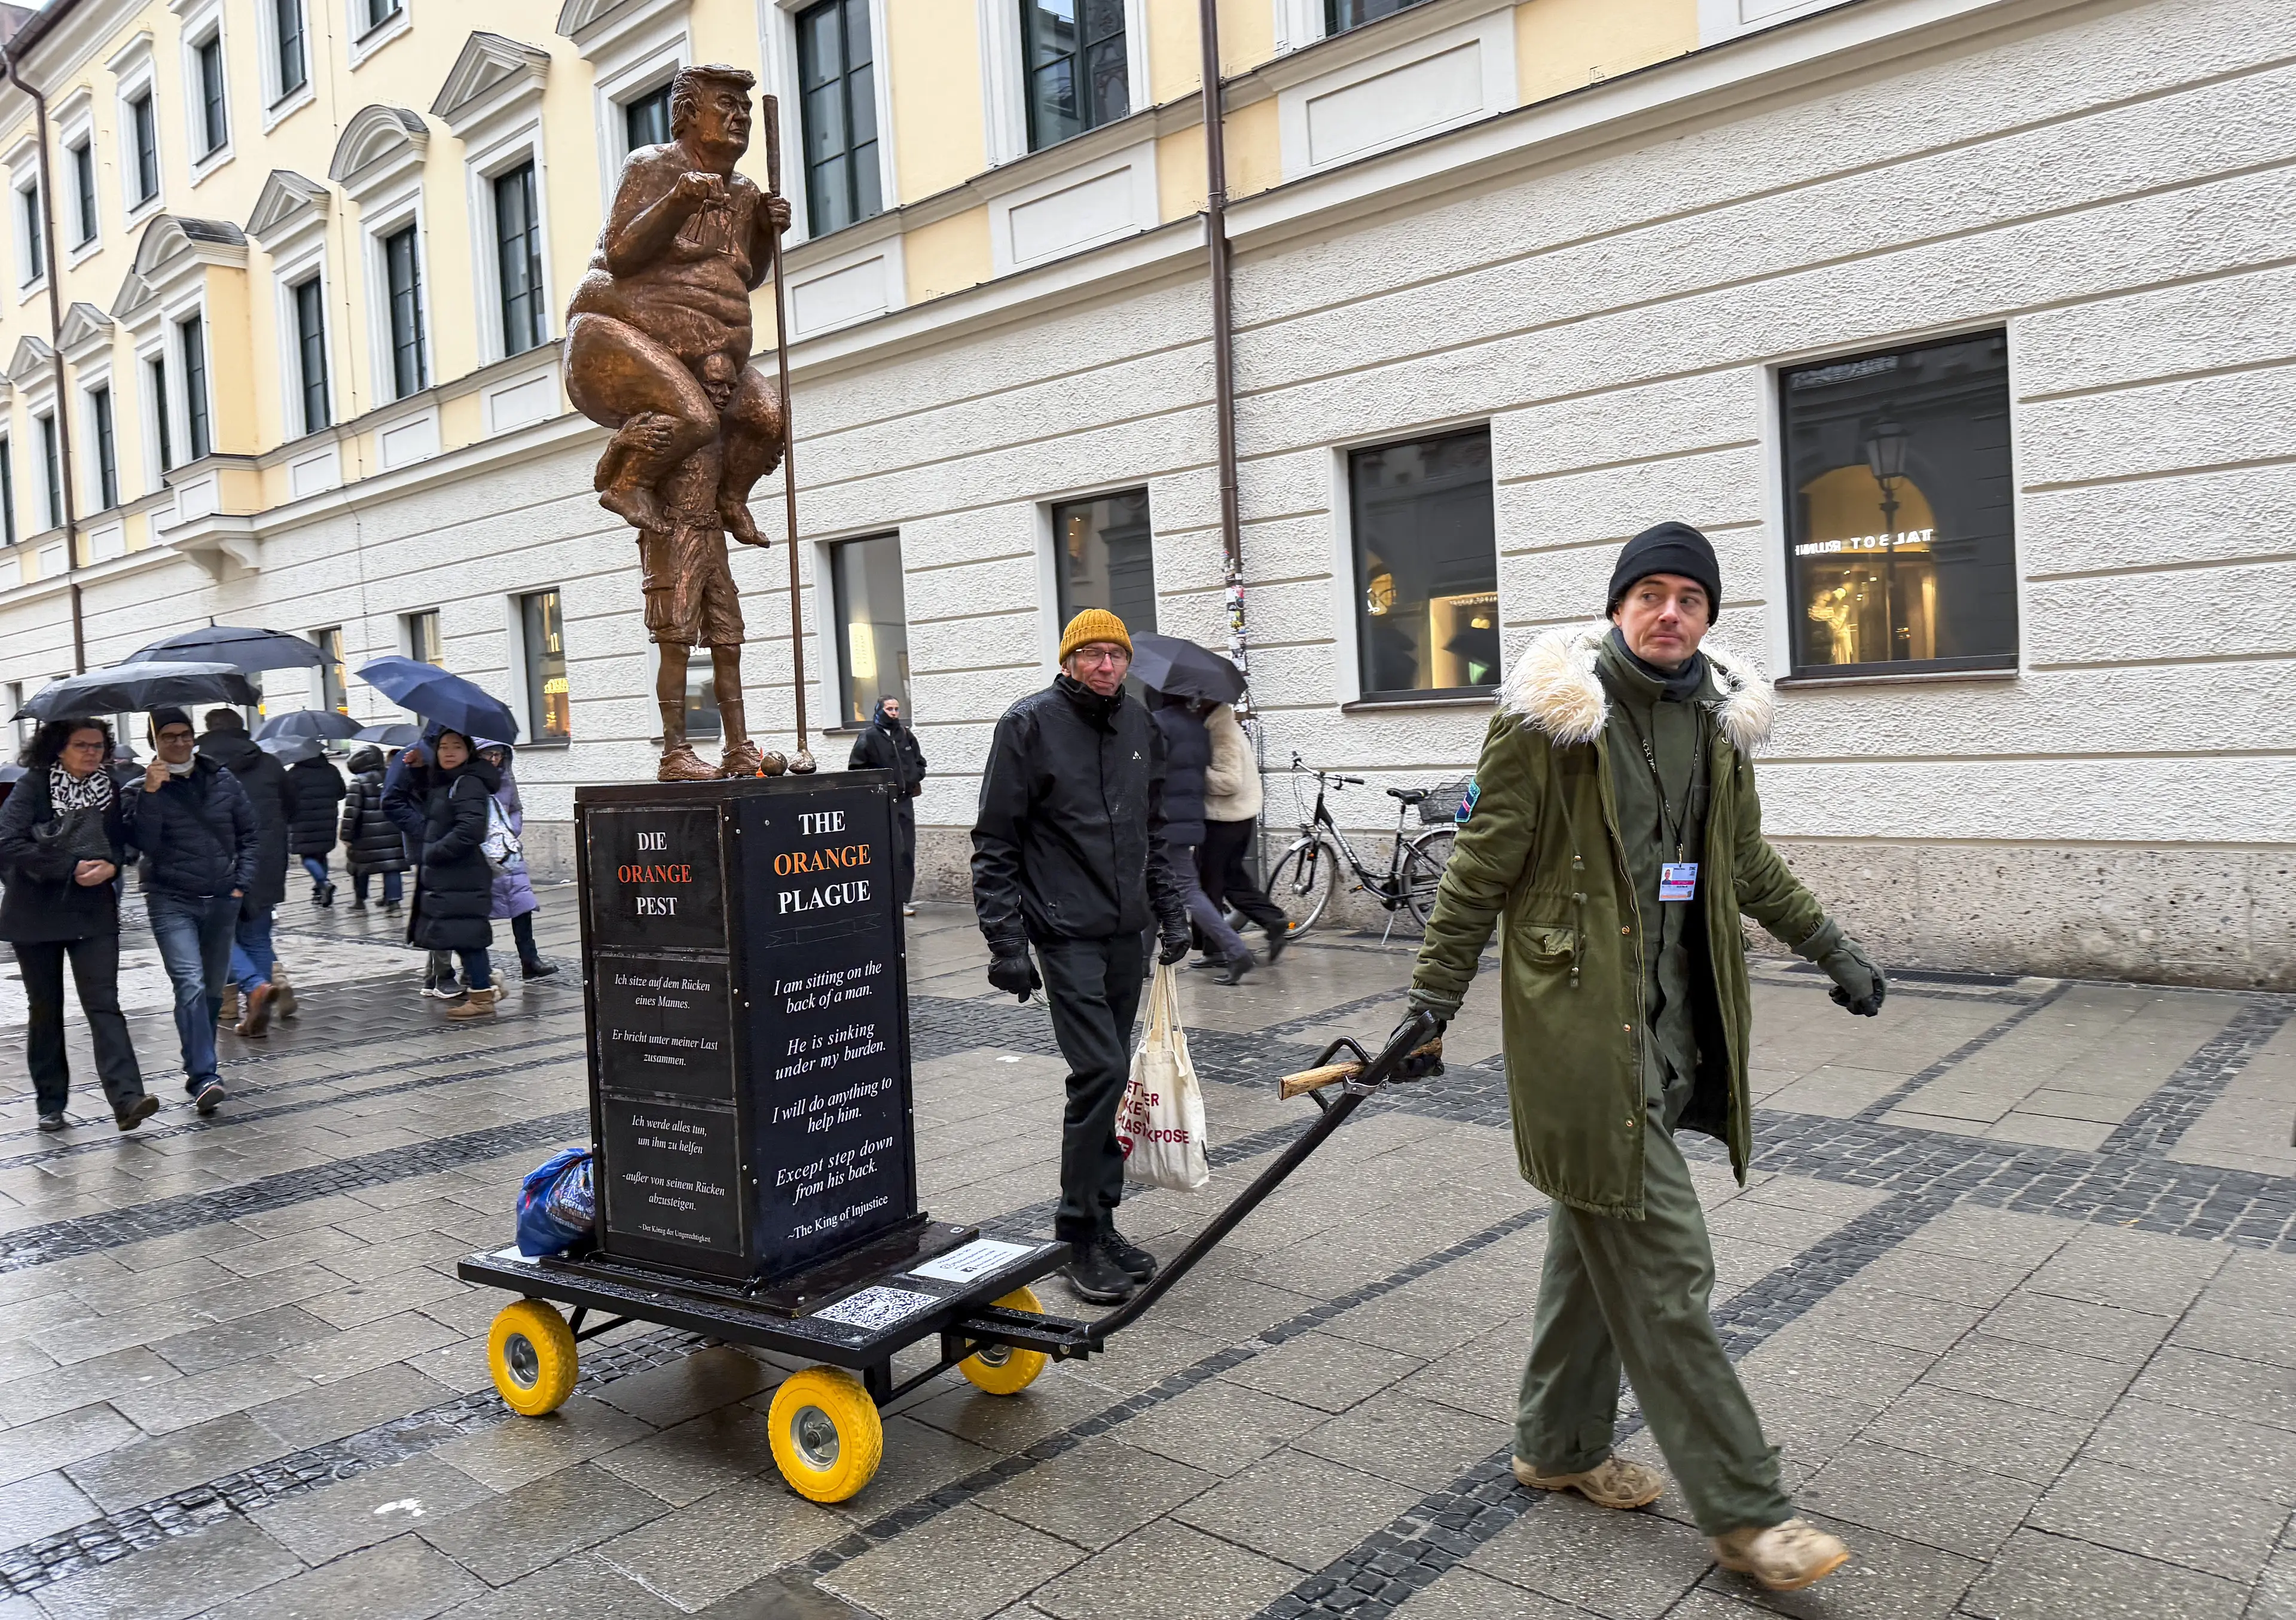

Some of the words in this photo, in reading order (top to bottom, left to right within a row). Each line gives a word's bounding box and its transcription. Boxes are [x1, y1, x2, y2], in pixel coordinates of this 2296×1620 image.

[798, 810, 845, 835] THE
[637, 832, 667, 850] DIE
[774, 844, 871, 875] ORANGE
[618, 864, 692, 883] ORANGE
[636, 897, 677, 916] PEST
[777, 880, 871, 914] PLAGUE
[615, 974, 627, 985] Ich
[628, 975, 647, 987] sitze
[648, 976, 664, 990] auf
[662, 977, 679, 989] dem
[681, 978, 710, 991] Rücken
[774, 980, 781, 996] I
[783, 980, 802, 994] am
[805, 970, 844, 989] sitting
[847, 968, 862, 980] on
[865, 960, 882, 976] the
[635, 994, 657, 1006] eines
[658, 995, 690, 1009] Mannes.
[786, 993, 816, 1014] back
[819, 988, 834, 1009] of
[833, 991, 842, 1003] a
[845, 985, 872, 1000] man.
[612, 1029, 623, 1040] Er
[624, 1030, 647, 1043] bricht
[649, 1036, 670, 1045] unter
[671, 1036, 699, 1048] meiner
[700, 1038, 718, 1050] Last
[787, 1038, 807, 1056] He
[812, 1035, 823, 1050] is
[828, 1024, 875, 1045] sinking
[643, 1054, 686, 1066] zusammen.
[775, 1058, 816, 1080] under
[820, 1053, 839, 1069] my
[844, 1039, 886, 1061] burden.
[772, 1106, 780, 1124] I
[781, 1098, 806, 1120] will
[808, 1094, 825, 1112] do
[828, 1082, 879, 1106] anything
[881, 1077, 892, 1090] to
[631, 1115, 645, 1127] Ich
[646, 1118, 671, 1130] werde
[671, 1120, 691, 1133] alles
[692, 1125, 707, 1137] tun,
[807, 1112, 834, 1133] help
[837, 1106, 862, 1124] him.
[638, 1137, 650, 1146] um
[652, 1136, 666, 1149] ihm
[667, 1142, 677, 1150] zu
[679, 1140, 703, 1155] helfen
[775, 1158, 823, 1186] Except
[828, 1149, 855, 1169] step
[860, 1136, 893, 1157] down
[651, 1177, 664, 1186] von
[666, 1178, 694, 1191] seinem
[695, 1180, 725, 1196] Rücken
[792, 1180, 824, 1206] from
[827, 1171, 845, 1189] his
[848, 1158, 878, 1180] back.
[648, 1192, 696, 1211] abzusteigen.
[814, 1215, 838, 1232] King
[839, 1206, 851, 1221] of
[851, 1195, 889, 1218] Injustice
